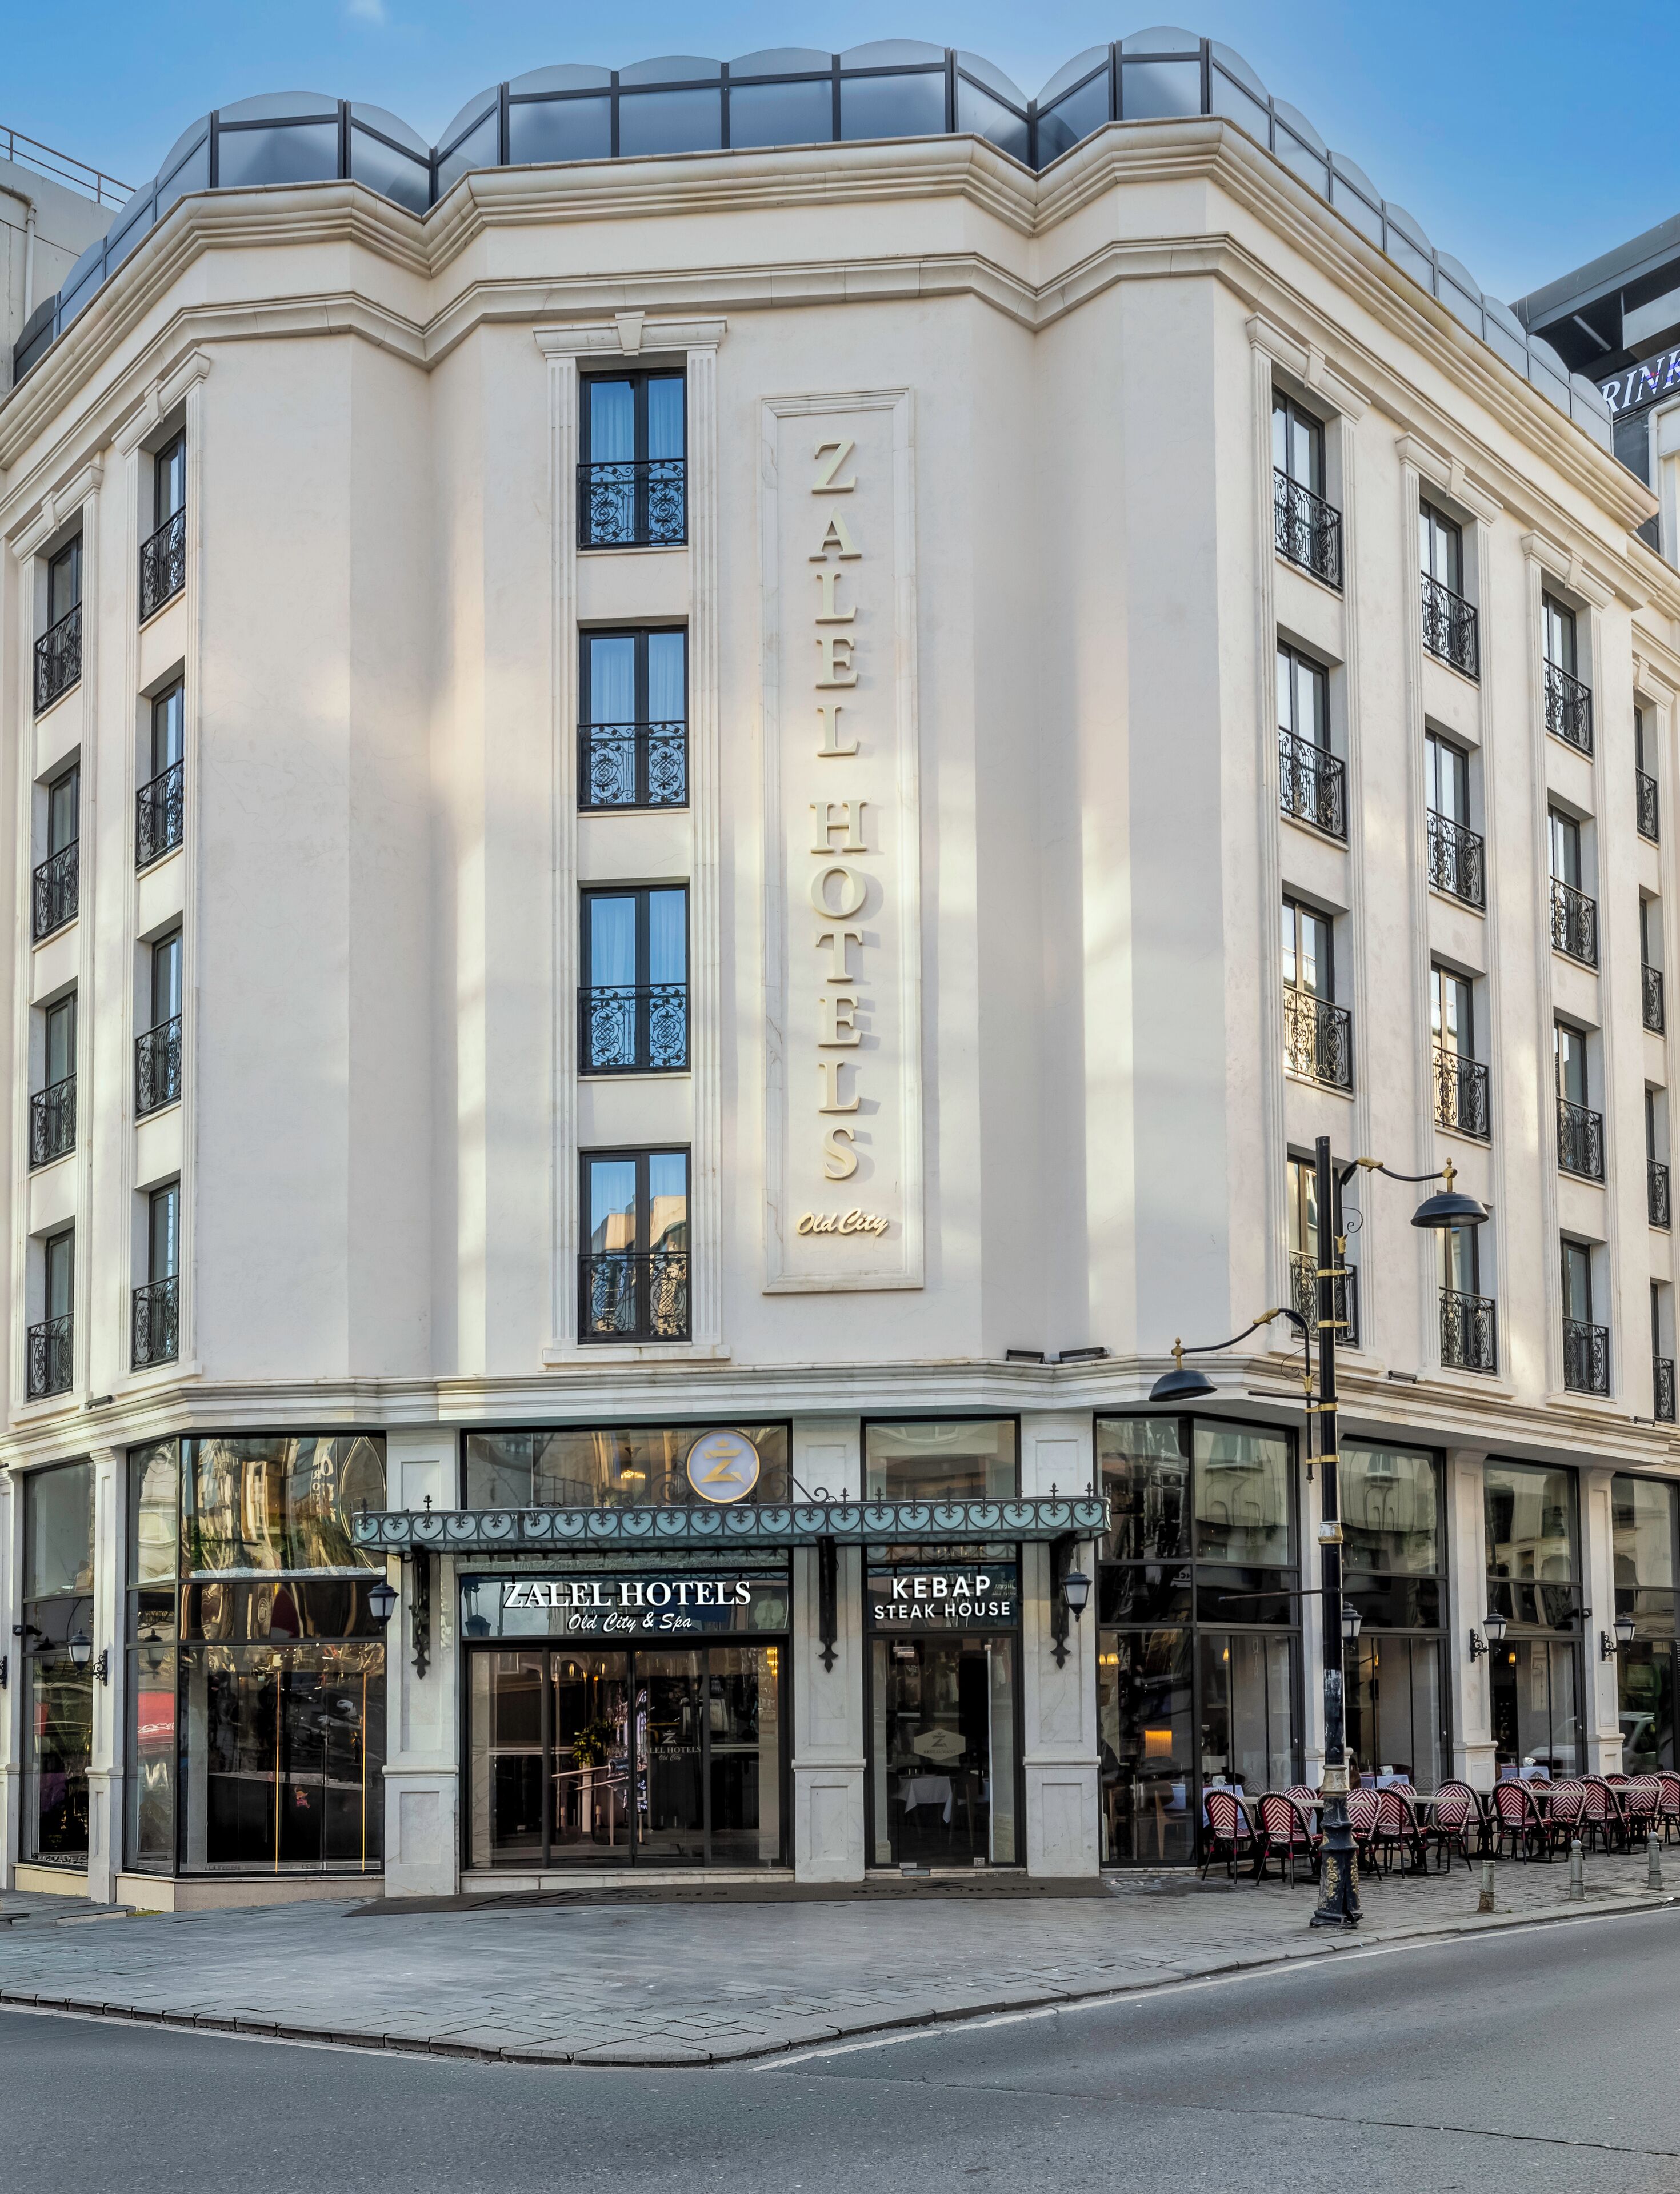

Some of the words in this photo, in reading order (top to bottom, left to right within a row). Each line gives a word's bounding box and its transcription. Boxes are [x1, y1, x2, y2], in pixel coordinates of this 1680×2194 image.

[809, 440, 862, 756] ZALEL
[810, 799, 868, 1179] HOTELS
[796, 1211, 838, 1235] Old
[838, 1208, 889, 1236] City
[504, 1582, 611, 1607] ZALEL
[618, 1581, 751, 1606] HOTELS
[893, 1575, 991, 1599] KEBAP
[568, 1613, 597, 1630] Old
[603, 1612, 637, 1632] City
[642, 1612, 654, 1626] &
[659, 1612, 692, 1631] Spa
[874, 1604, 935, 1619] STEAK
[945, 1602, 1010, 1617] HOUSE
